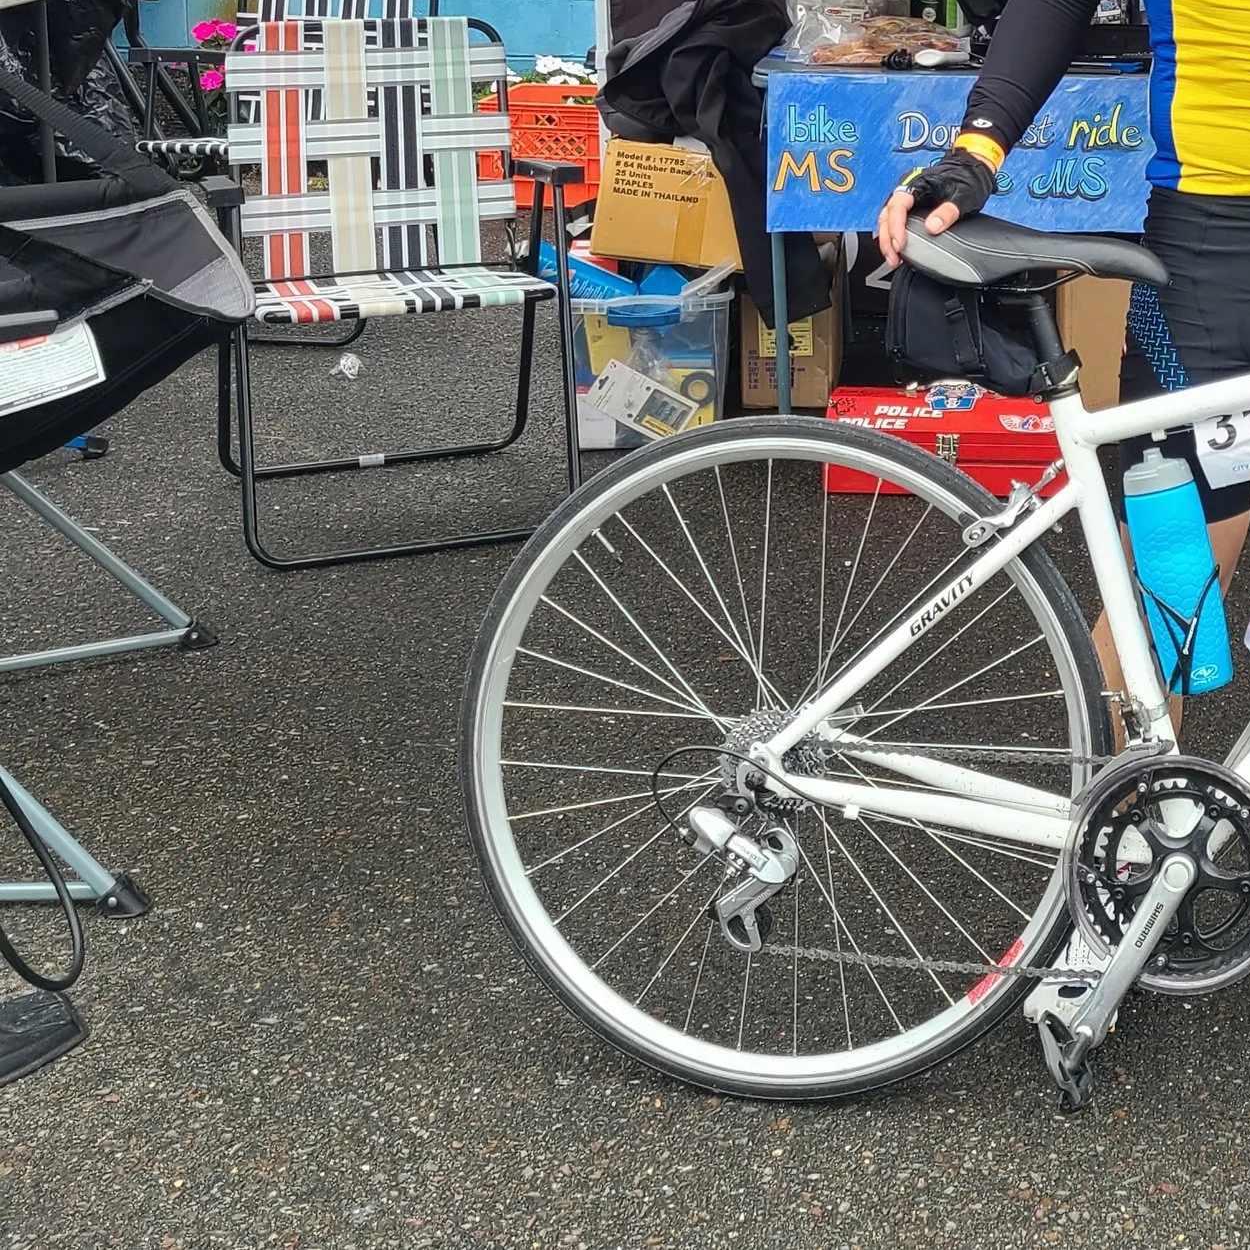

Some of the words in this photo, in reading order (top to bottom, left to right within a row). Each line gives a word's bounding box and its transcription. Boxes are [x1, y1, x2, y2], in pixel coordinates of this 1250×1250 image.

[787, 104, 860, 146] bike
[1067, 101, 1143, 149] ride
[616, 151, 643, 162] Model
[659, 157, 685, 166] 17785
[624, 160, 634, 169] 64
[636, 162, 668, 173] Rubber
[772, 147, 856, 194] MS
[1028, 156, 1109, 201] MS
[615, 169, 627, 177] 25
[629, 170, 652, 180] Units
[614, 178, 654, 190] STAPLES
[612, 186, 639, 196] MADE
[641, 190, 651, 199] IN
[653, 191, 699, 204] THAILAND
[873, 405, 944, 419] POLICE
[1232, 461, 1250, 472] CITY
[908, 569, 976, 637] GRAVITY
[1134, 901, 1165, 949] SHIMANO
